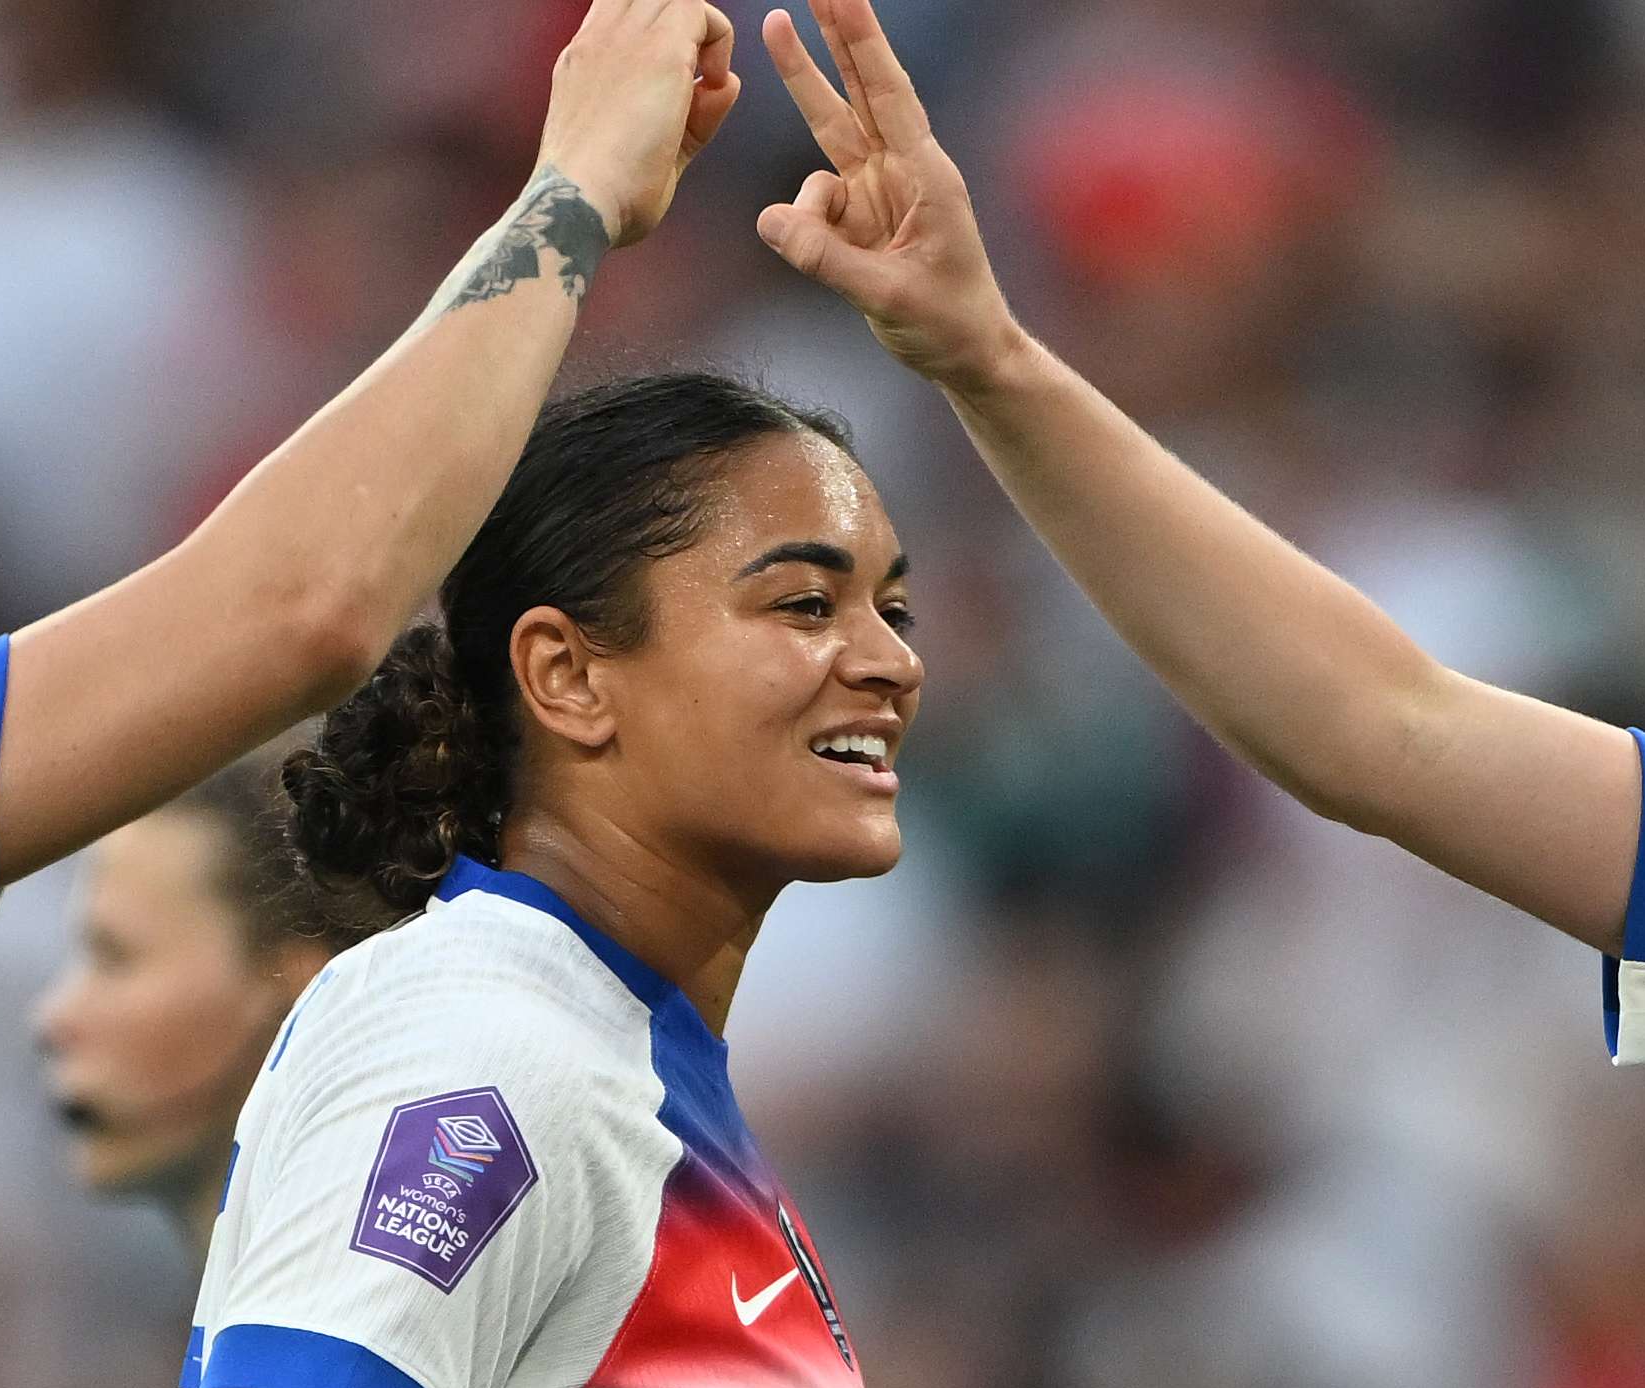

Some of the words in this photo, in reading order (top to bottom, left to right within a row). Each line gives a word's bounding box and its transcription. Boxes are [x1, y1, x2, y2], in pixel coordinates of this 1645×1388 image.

[400, 1185, 467, 1224] women's
[423, 1176, 458, 1199] UEFA
[374, 1212, 456, 1262] LEAGUE
[376, 1194, 469, 1248] NATIONS
